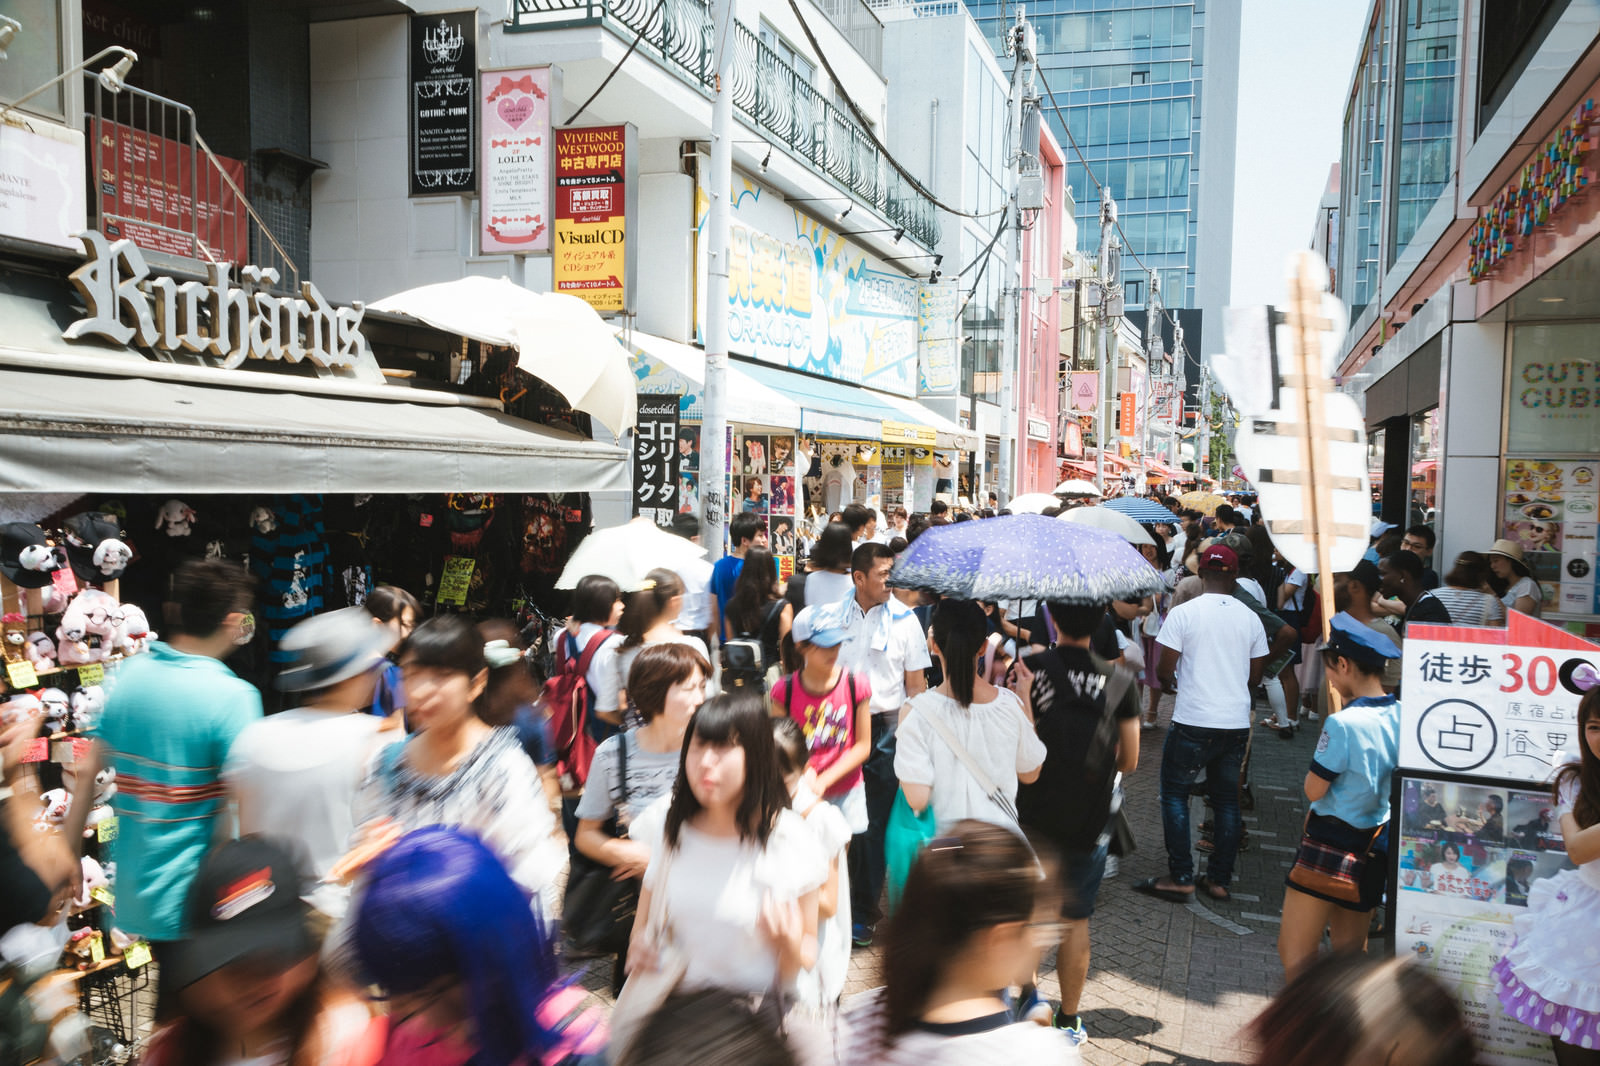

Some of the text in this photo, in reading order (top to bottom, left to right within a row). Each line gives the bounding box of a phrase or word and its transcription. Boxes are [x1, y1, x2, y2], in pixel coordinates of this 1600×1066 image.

[564, 130, 619, 143] VIVIENNE
[558, 142, 624, 155] WESTWOOD
[498, 155, 534, 164] LOLITA
[560, 154, 622, 170] 中古専門店
[563, 250, 616, 261] ヴィジュアル系
[563, 262, 605, 272] CDショップ
[639, 403, 676, 415] closet child
[637, 420, 658, 502] ゴシック
[658, 422, 676, 503] ロリータ
[1438, 714, 1483, 752] 占
